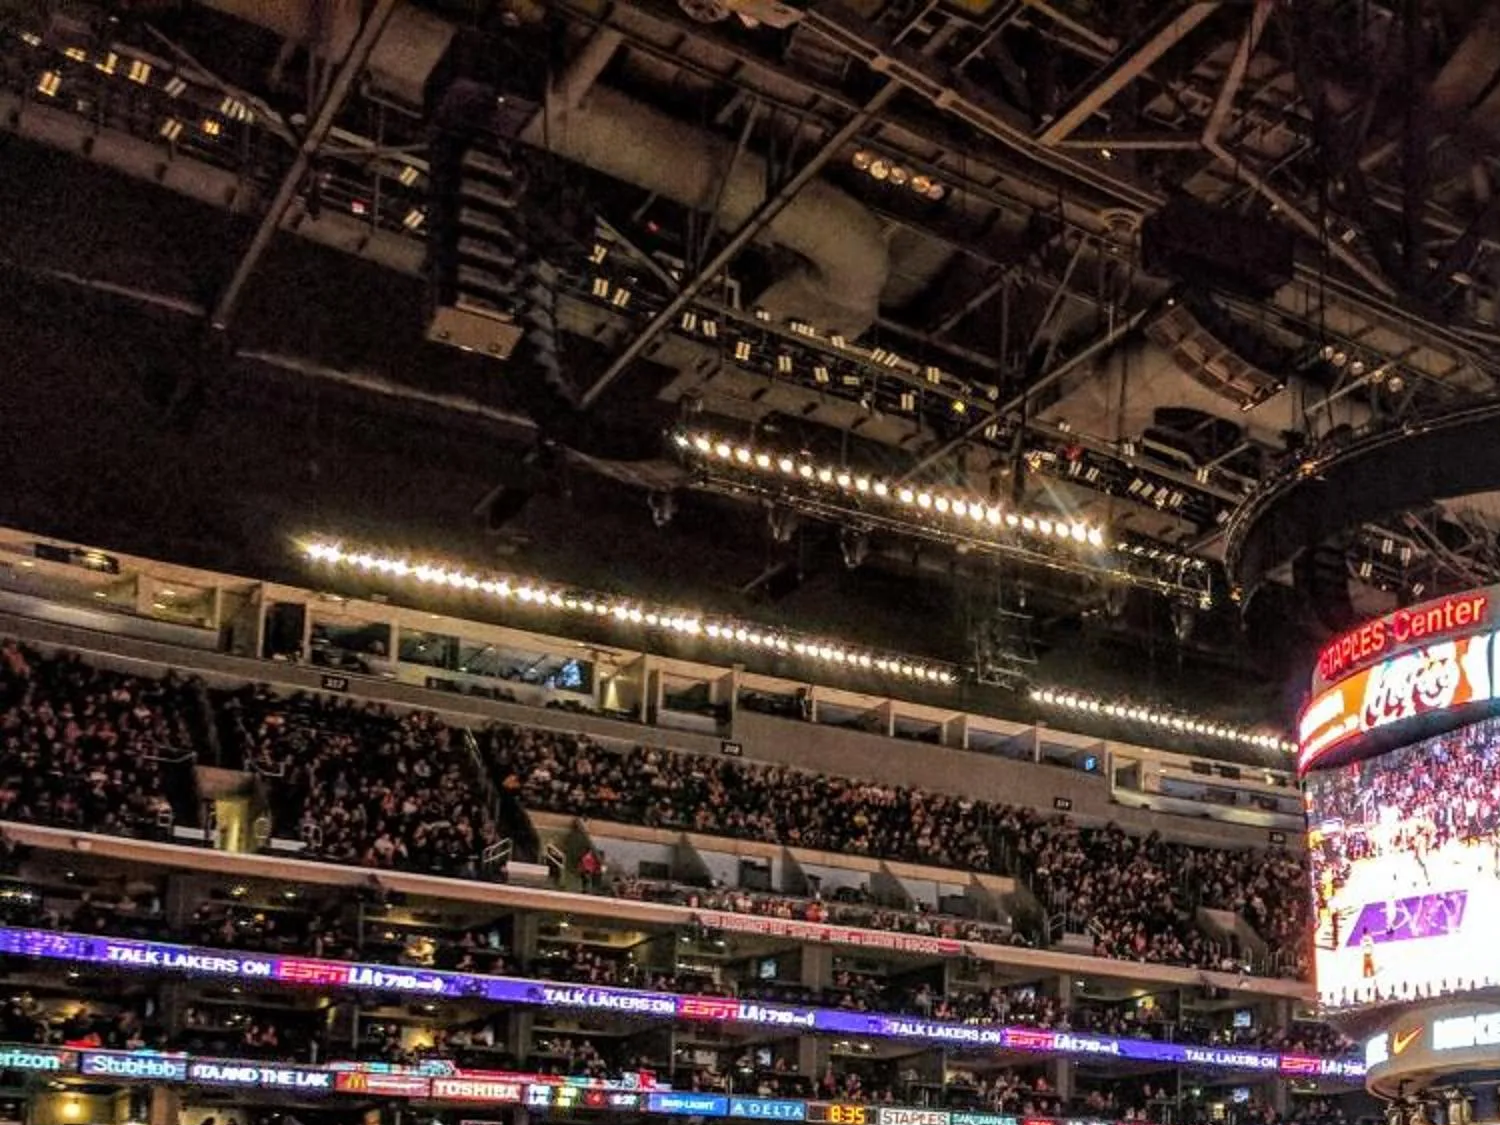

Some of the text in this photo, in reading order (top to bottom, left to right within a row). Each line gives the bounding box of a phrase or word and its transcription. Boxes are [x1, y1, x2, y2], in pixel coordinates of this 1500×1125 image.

[1320, 597, 1486, 680] STAPLES Center
[107, 946, 159, 965] TALK
[163, 954, 238, 973] LAKERS
[242, 960, 271, 976] ON
[280, 961, 347, 981] ESPN
[544, 990, 584, 1004] TALK
[588, 991, 648, 1010] LAKERS
[649, 1000, 675, 1013] ON
[680, 1002, 737, 1018] ESPN
[892, 1022, 925, 1035] TALK
[928, 1026, 978, 1041] LAKERS
[981, 1031, 1000, 1043] ON
[94, 1055, 175, 1077] StubHub
[1186, 1050, 1214, 1063] TALK
[1217, 1053, 1257, 1067] LAKERS
[1259, 1057, 1277, 1068] ON
[436, 1082, 519, 1100] TOSHIBA
[750, 1103, 804, 1117] DELTA
[830, 1105, 865, 1124] 8:35
